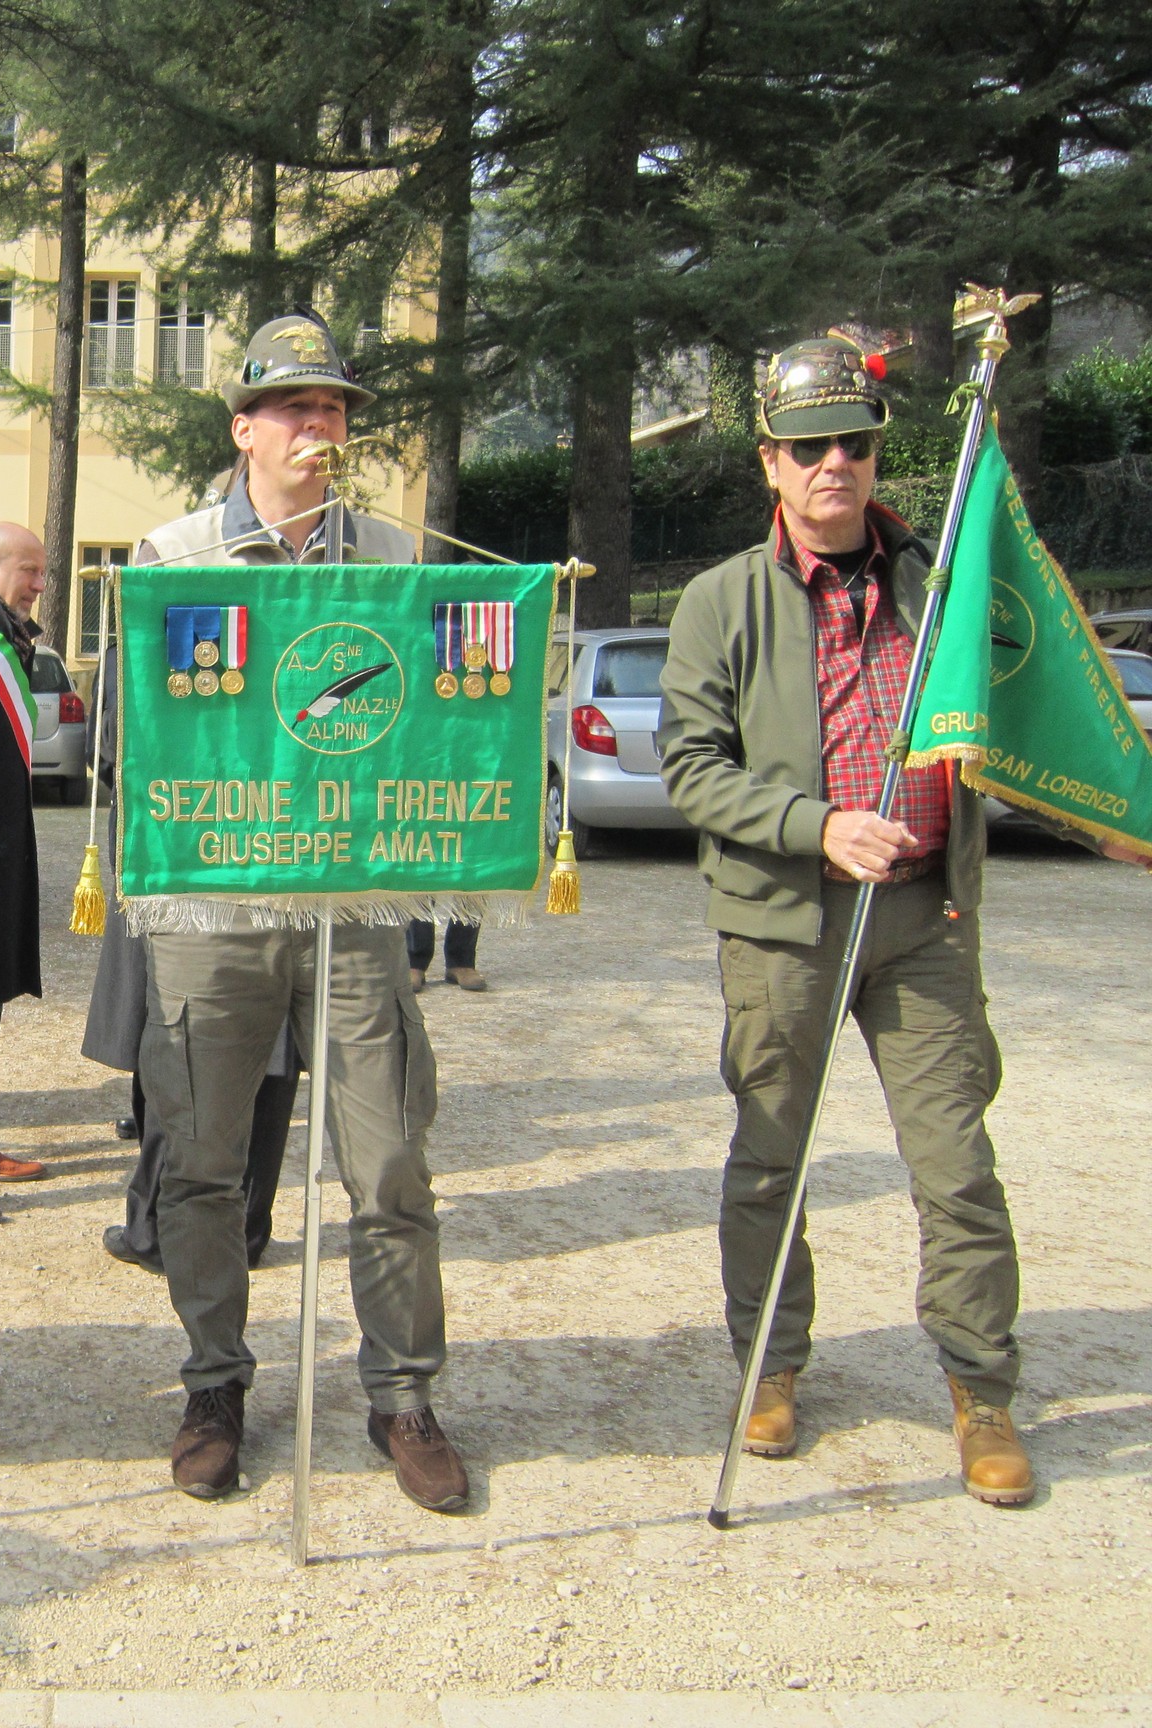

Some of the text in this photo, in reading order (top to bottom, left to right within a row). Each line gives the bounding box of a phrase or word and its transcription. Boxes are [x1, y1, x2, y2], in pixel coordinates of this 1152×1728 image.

[1006, 476, 1134, 756] SEZIONE DI FIRENZE
[306, 722, 368, 740] ALPINI
[148, 779, 513, 823] SEZIONE DI FIRENZE
[986, 748, 1034, 783] SAN
[1035, 769, 1129, 818] LORENZO
[198, 830, 464, 865] GIUSEPPE AMATI
